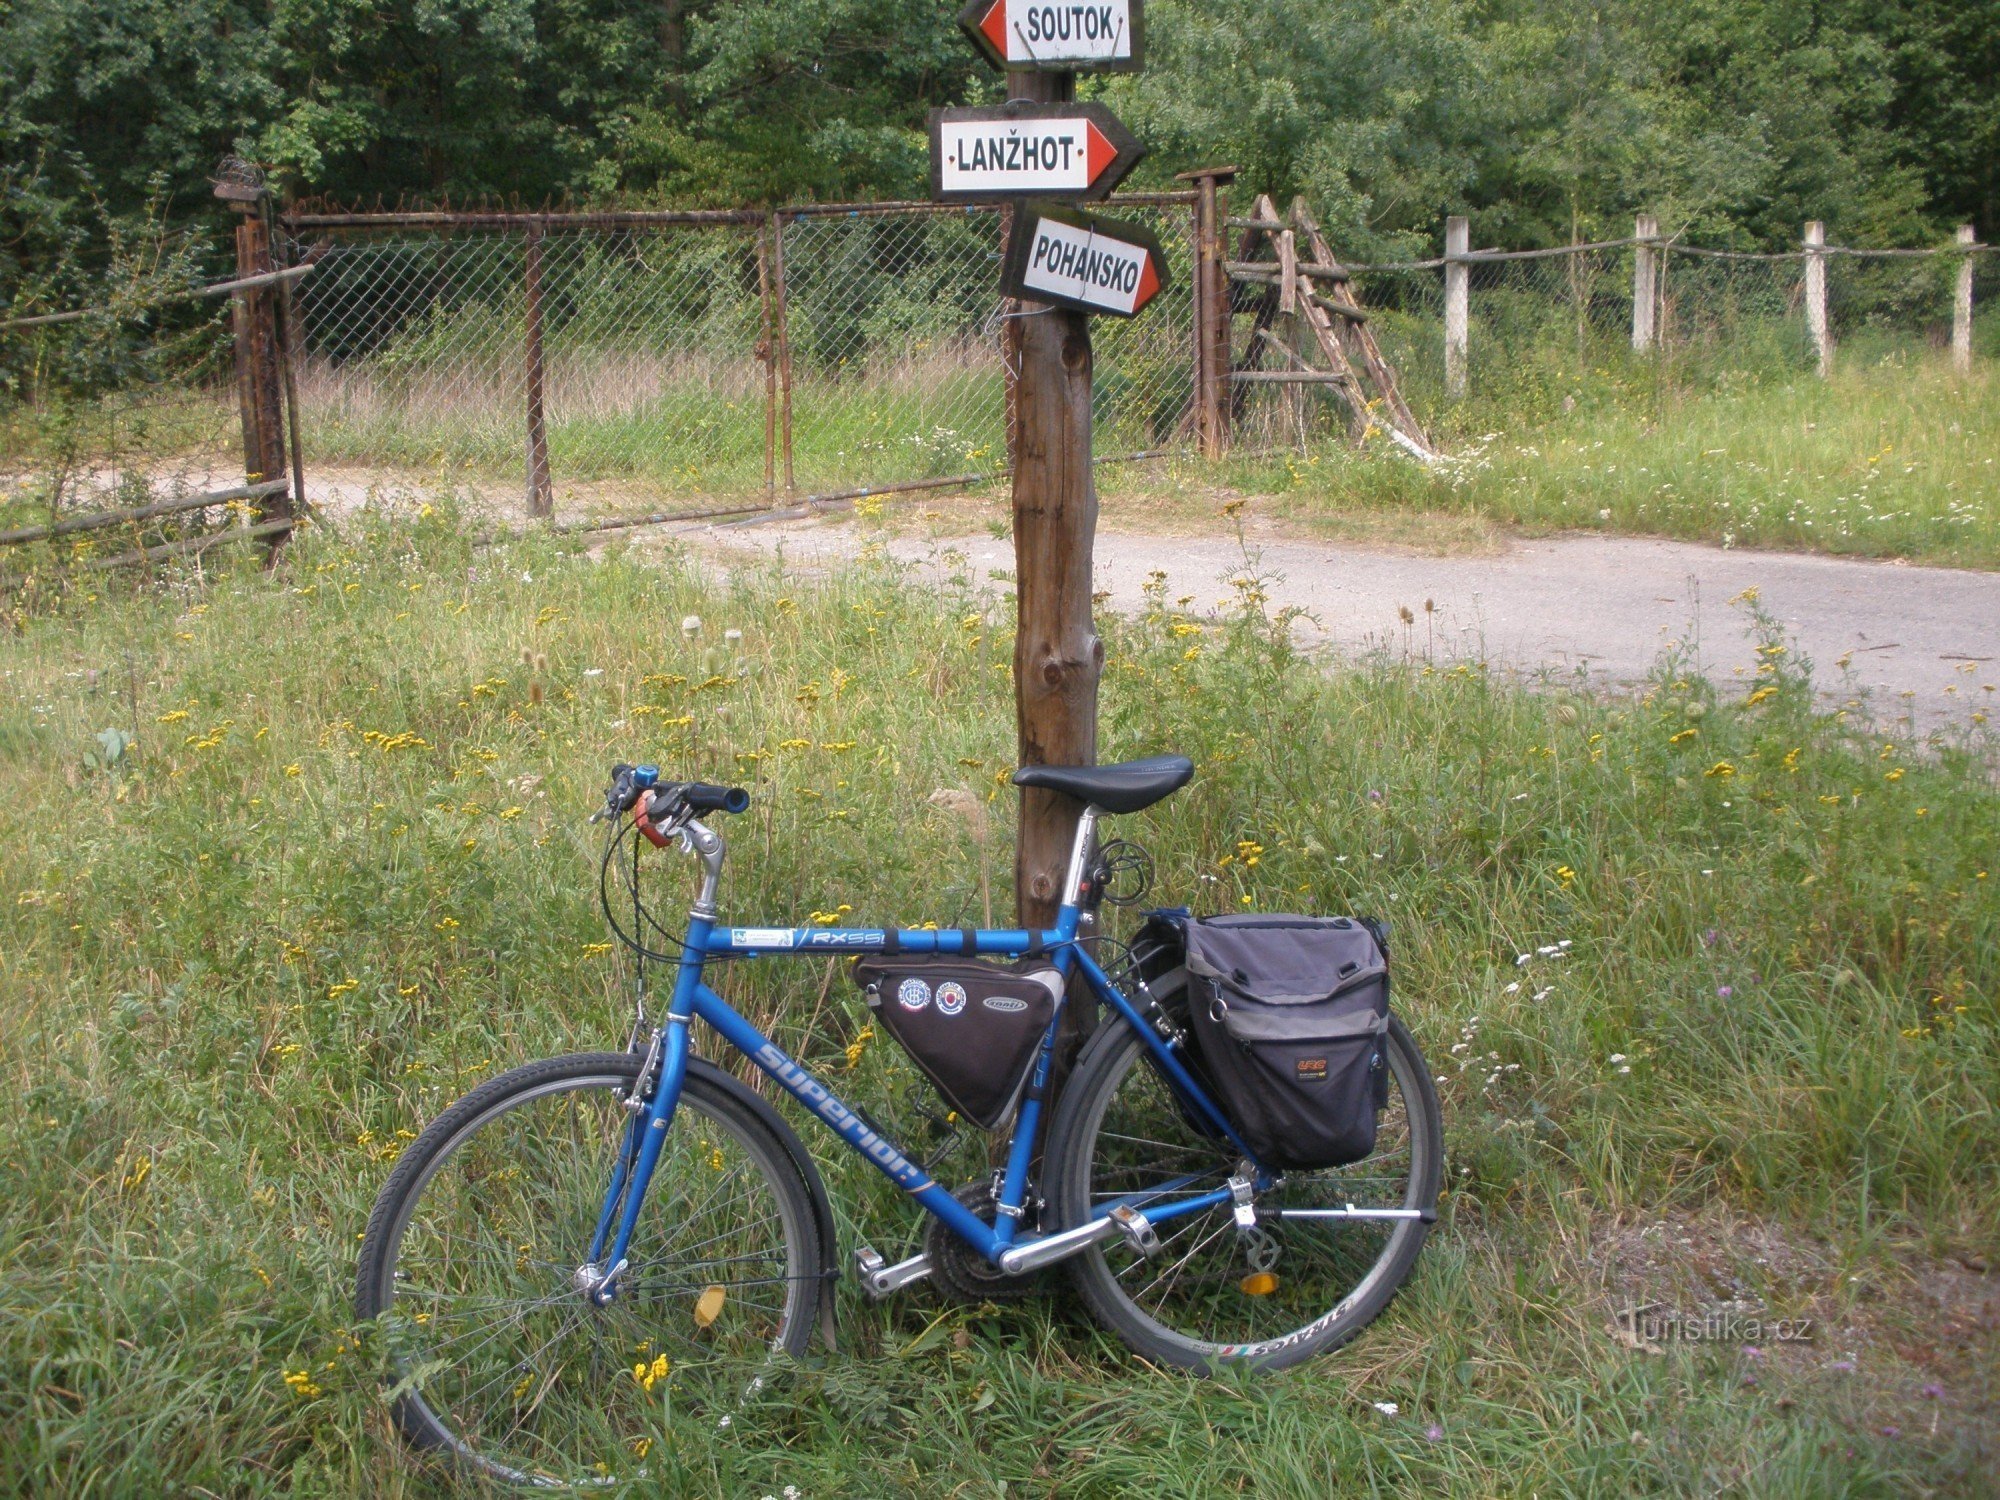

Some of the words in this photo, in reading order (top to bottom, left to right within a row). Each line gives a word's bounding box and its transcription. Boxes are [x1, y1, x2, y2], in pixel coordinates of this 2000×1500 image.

[1027, 5, 1115, 42] SOUTOK
[957, 128, 1074, 172] LANŽHOT
[1033, 235, 1139, 295] POHANSKO
